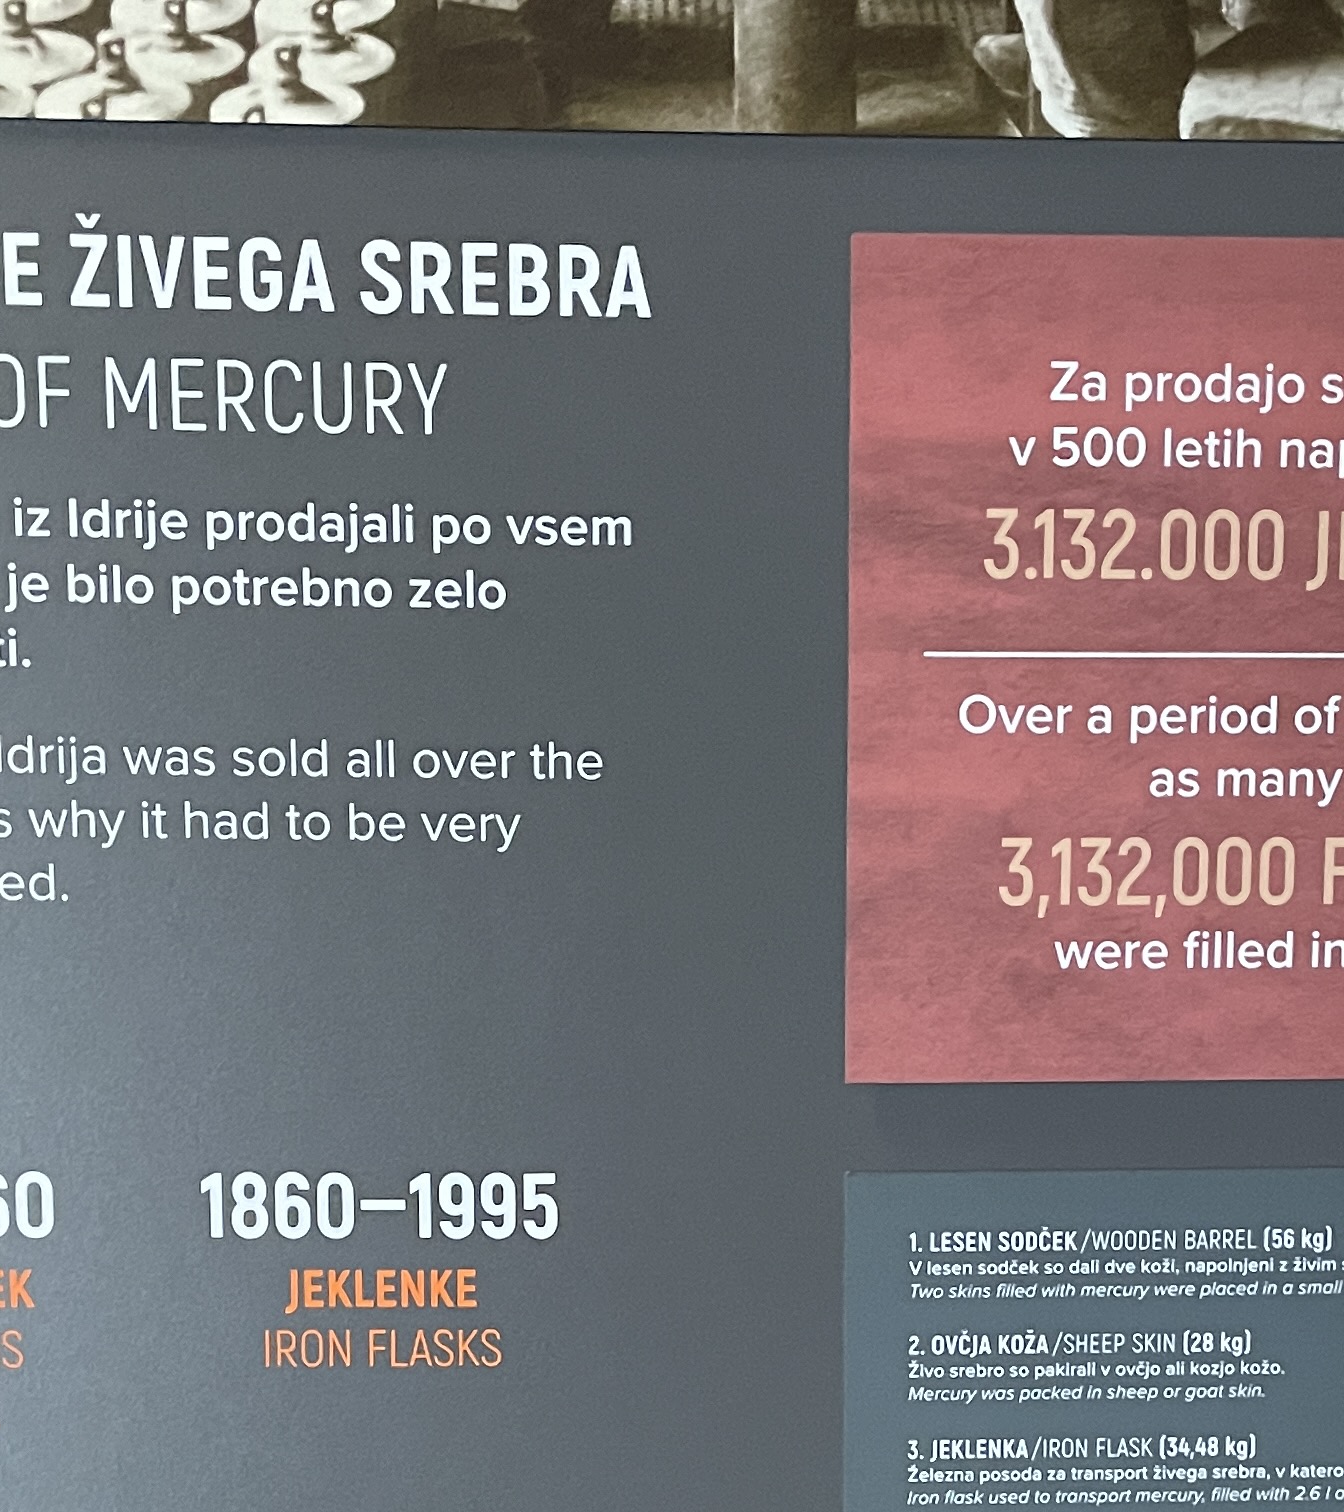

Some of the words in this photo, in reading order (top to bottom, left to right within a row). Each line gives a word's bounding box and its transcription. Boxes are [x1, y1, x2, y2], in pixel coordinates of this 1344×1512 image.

[70, 213, 334, 312] ŽIVEGA
[360, 239, 651, 317] SREBRA
[105, 357, 447, 434] MERCURY
[1050, 361, 1106, 401] Za
[1126, 363, 1305, 413] prodajo
[1009, 437, 1036, 466] v
[1053, 427, 1146, 467] 500
[1164, 428, 1261, 467] letih
[14, 497, 50, 536] iz
[69, 498, 187, 549] Idrije
[207, 503, 413, 553] prodajali
[433, 515, 490, 553] po
[506, 516, 631, 545] vsem
[984, 508, 1284, 581] 3.132.000
[5, 563, 49, 612] je
[67, 564, 153, 604] bilo
[172, 567, 392, 614] potrebno
[409, 570, 506, 609] zelo
[960, 695, 1072, 734] Over
[1088, 705, 1111, 734] a
[1131, 696, 1277, 743] period
[1295, 695, 1341, 734] of
[123, 747, 215, 776] was
[233, 739, 327, 777] sold
[347, 740, 394, 777] all
[413, 750, 515, 779] over
[530, 742, 603, 780] the
[1150, 768, 1199, 797] as
[1218, 768, 1343, 807] many
[999, 837, 1295, 918] 3,132,000
[1055, 941, 1168, 969] were
[1183, 931, 1293, 968] filled
[910, 1233, 922, 1252] 1.
[930, 1232, 991, 1252] LESEN
[1185, 1229, 1256, 1249] BARREL
[1264, 1226, 1294, 1251] (56
[1302, 1226, 1332, 1253] kg)
[909, 1261, 922, 1275] V
[927, 1261, 972, 1275] lesen
[978, 1260, 1038, 1274] sodček
[1044, 1263, 1063, 1274] so
[1069, 1260, 1099, 1274] dali
[1105, 1260, 1135, 1273] dve
[1141, 1258, 1179, 1274] koži,
[1186, 1258, 1273, 1275] napolnjeni
[1280, 1261, 1287, 1272] z
[1293, 1257, 1336, 1271] živim
[285, 1269, 476, 1314] JEKLENKE
[264, 1329, 352, 1368] IRON
[368, 1328, 502, 1368] FLASKS
[909, 1360, 944, 1378] Živo
[950, 1364, 1004, 1378] srebro
[1010, 1366, 1029, 1377] so
[1035, 1362, 1095, 1380] pakirali
[1101, 1366, 1110, 1376] v
[1116, 1361, 1160, 1379] ovčjo
[1166, 1361, 1184, 1375] ali
[1191, 1361, 1235, 1378] kozjo
[1241, 1360, 1284, 1374] kožo.
[908, 1387, 977, 1404] Mercury
[982, 1389, 1014, 1400] was
[1019, 1386, 1083, 1403] packed
[1087, 1386, 1102, 1398] in
[1107, 1385, 1158, 1401] sheep
[1163, 1387, 1181, 1398] or
[1185, 1385, 1224, 1402] goat
[1229, 1384, 1265, 1397] skin.
